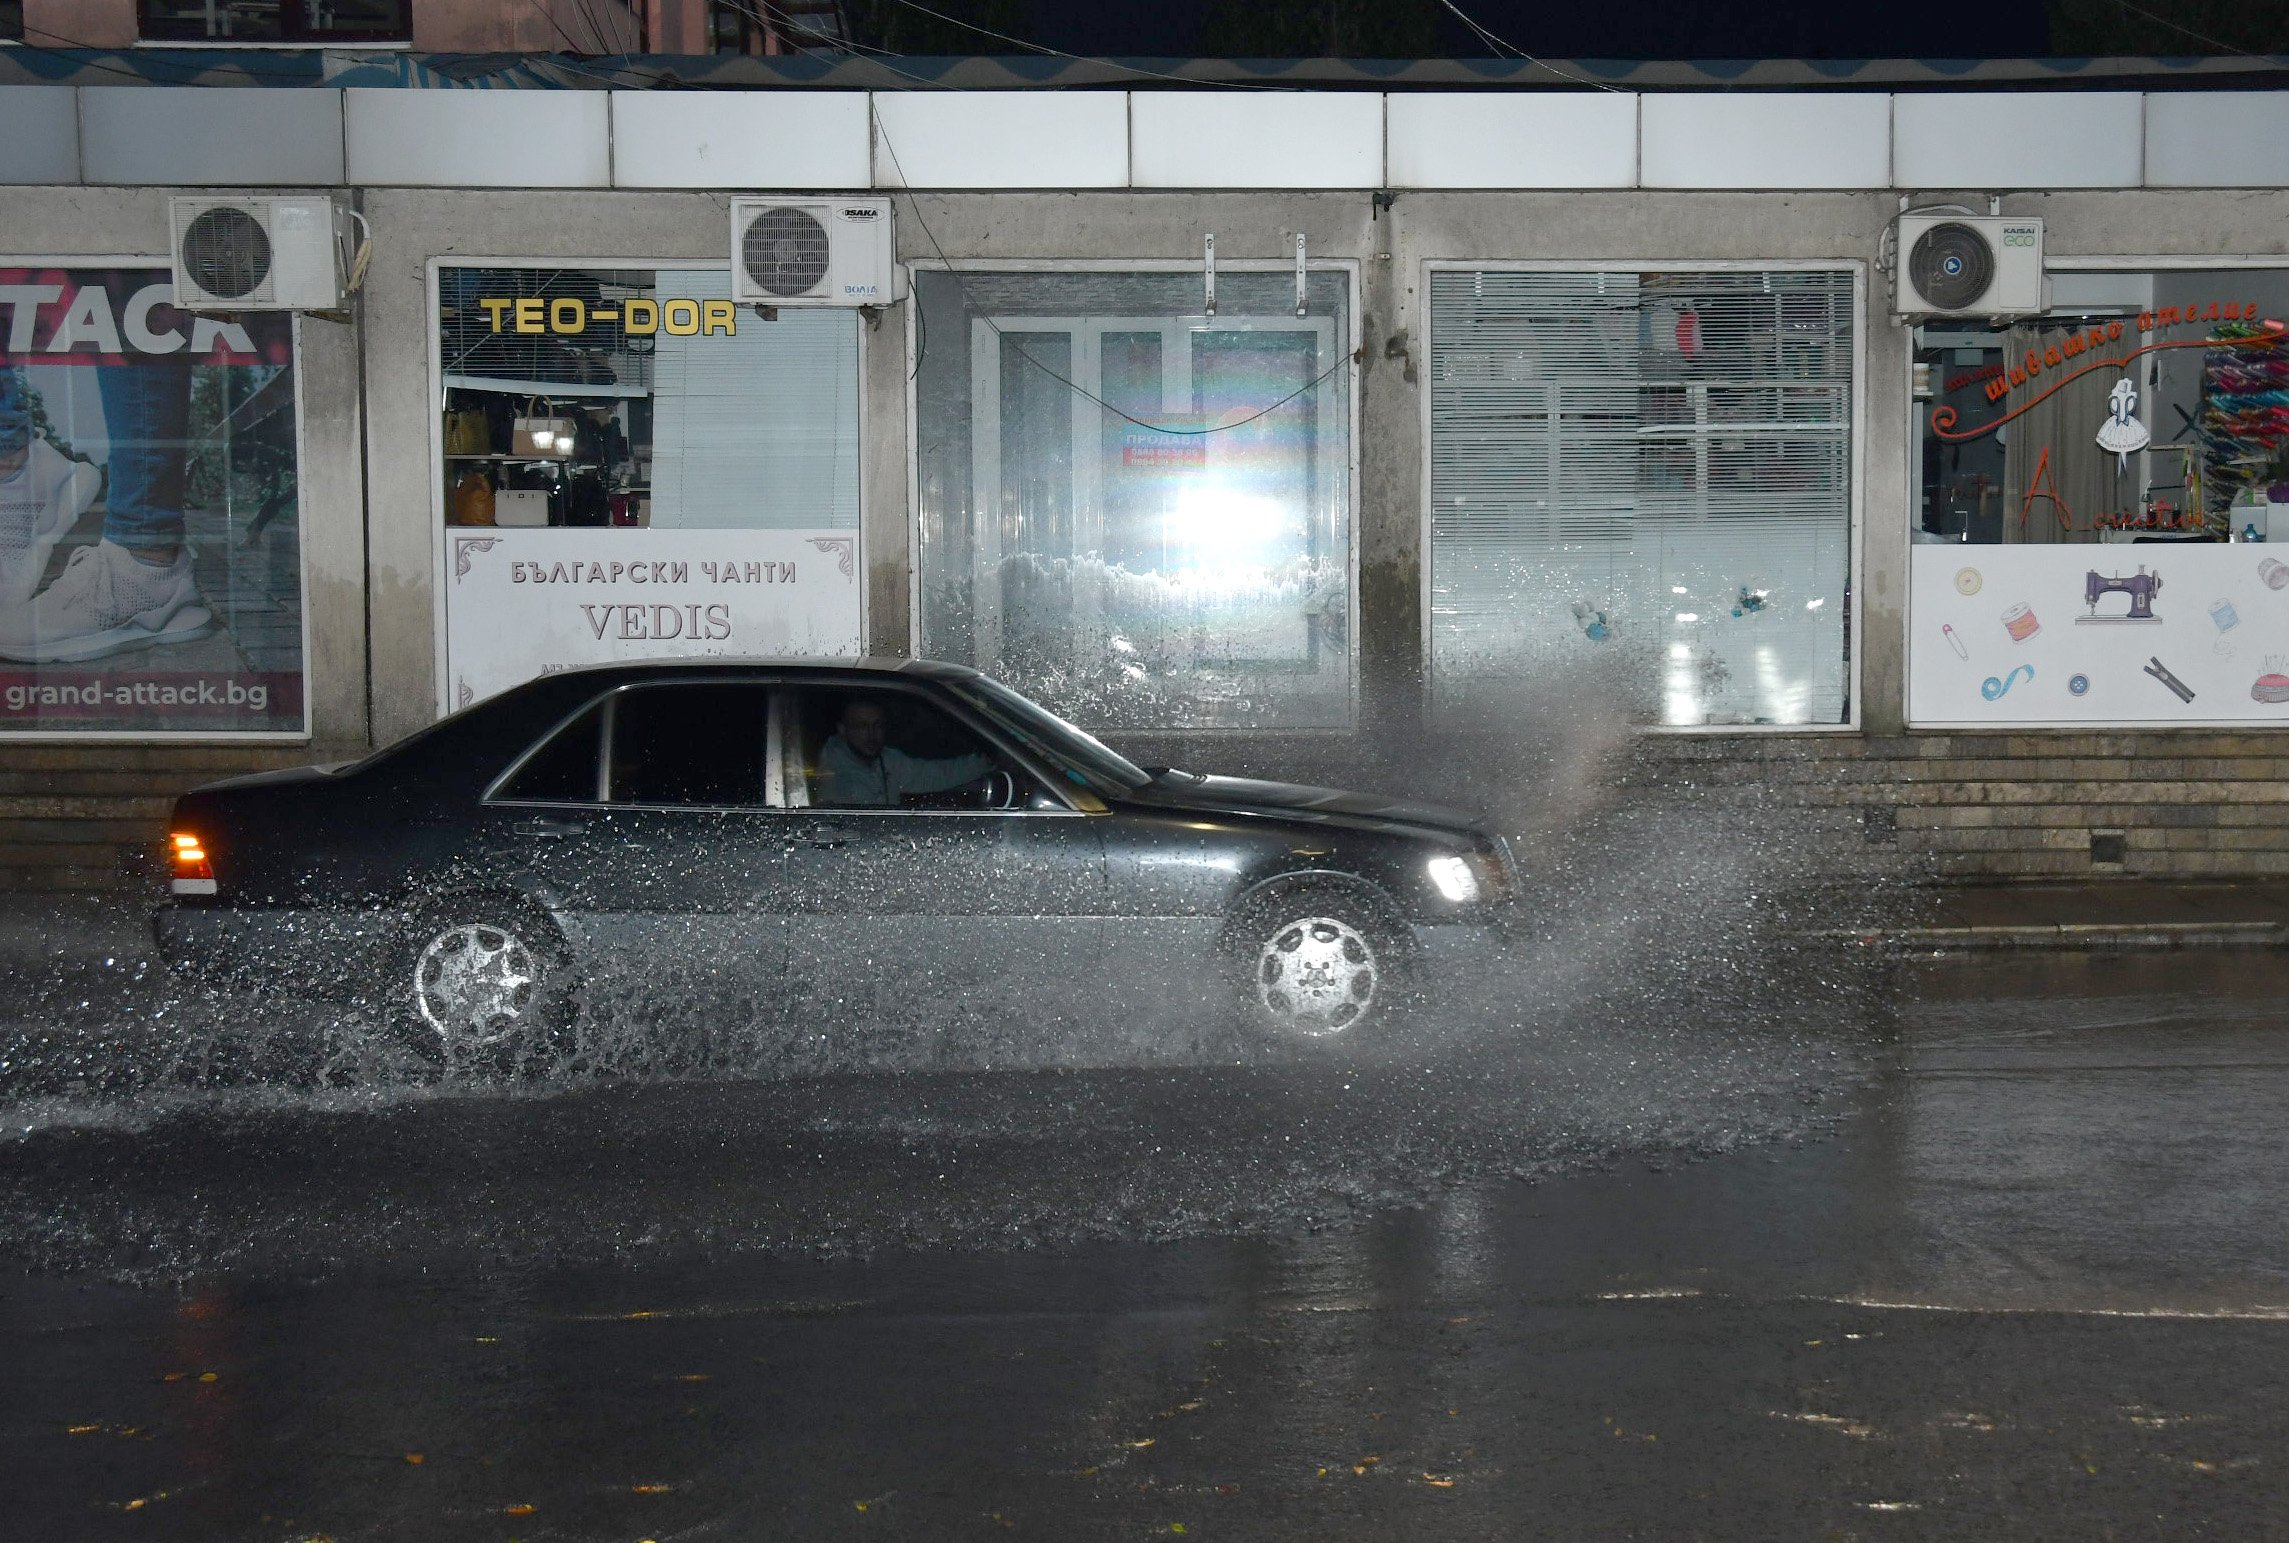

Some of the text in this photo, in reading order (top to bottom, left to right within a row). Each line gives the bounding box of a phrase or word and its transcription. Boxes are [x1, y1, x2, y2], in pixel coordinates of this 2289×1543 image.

[2003, 235, 2035, 247] eco
[480, 298, 737, 336] TEO-DOR
[1984, 320, 2124, 401] шивашко
[2136, 299, 2258, 333] ателие
[511, 561, 797, 583] БЪЛГАРСКИ ЧАНТИ
[579, 603, 732, 640] VEDIS
[5, 680, 268, 710] grand-attack.bg
